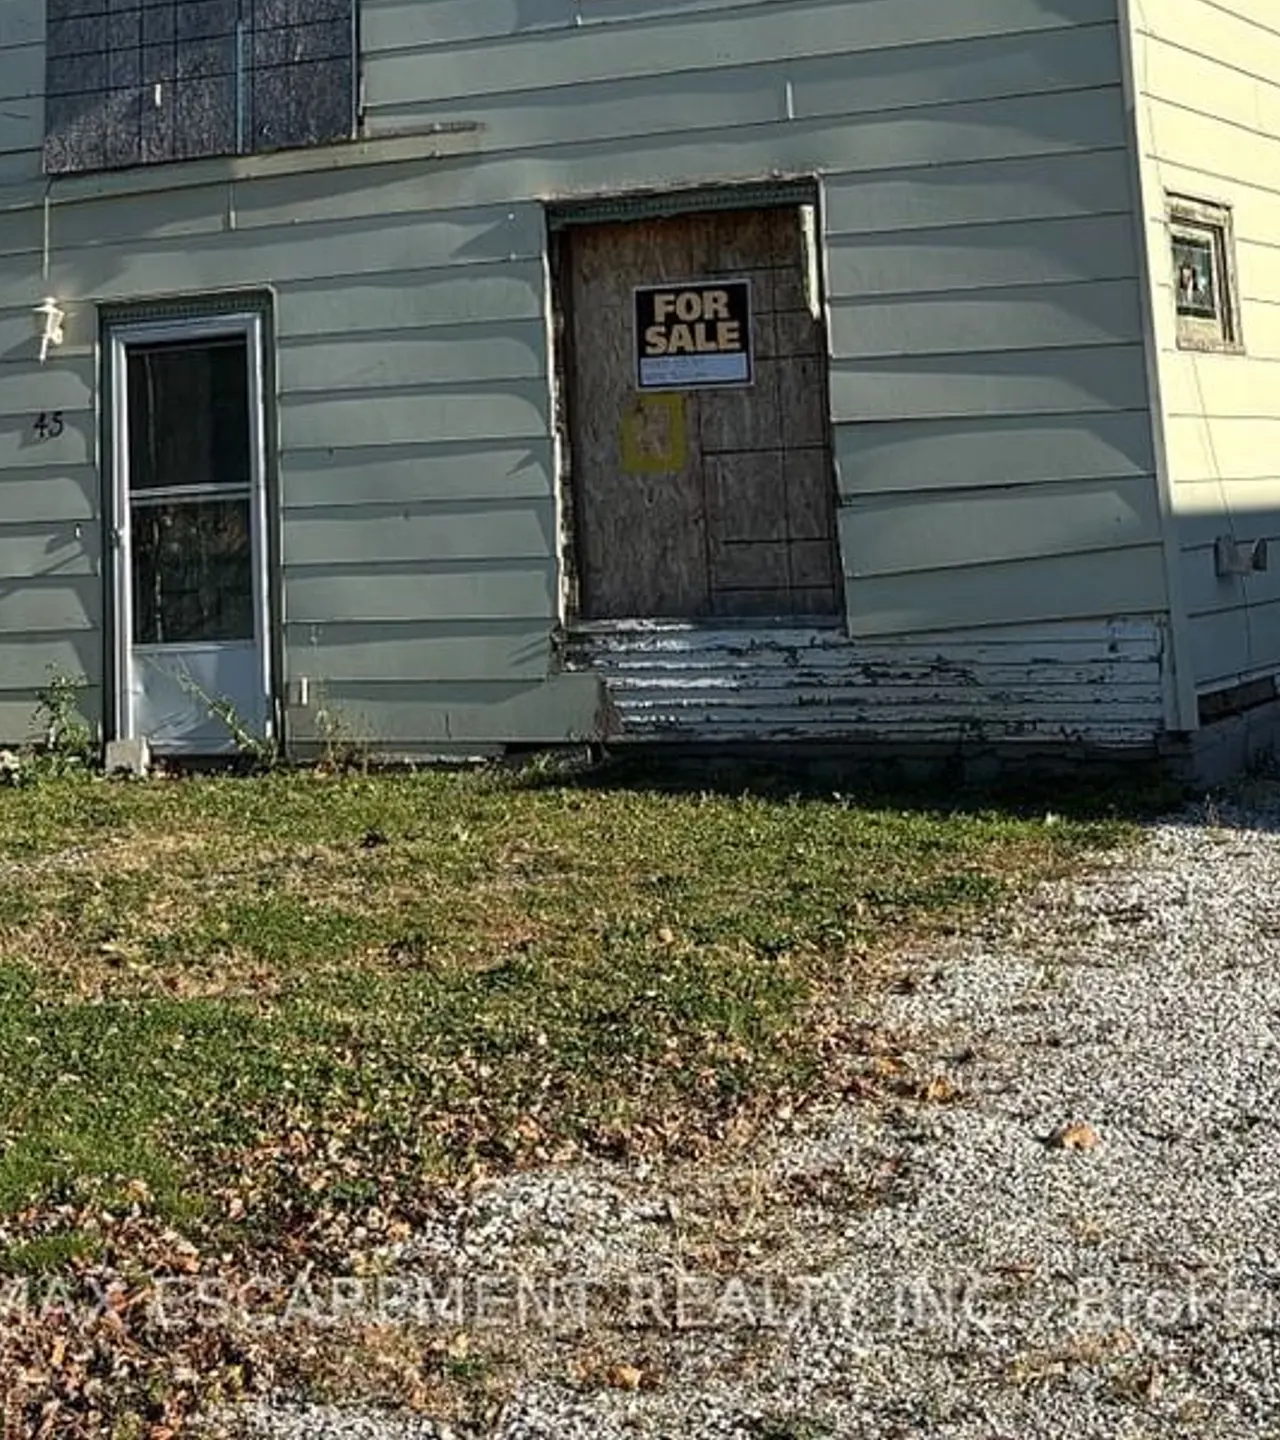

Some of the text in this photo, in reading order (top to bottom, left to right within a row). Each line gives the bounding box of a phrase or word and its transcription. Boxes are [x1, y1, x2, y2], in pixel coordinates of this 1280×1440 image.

[653, 290, 730, 323] FOR
[645, 321, 741, 355] SALE
[32, 411, 64, 438] 45
